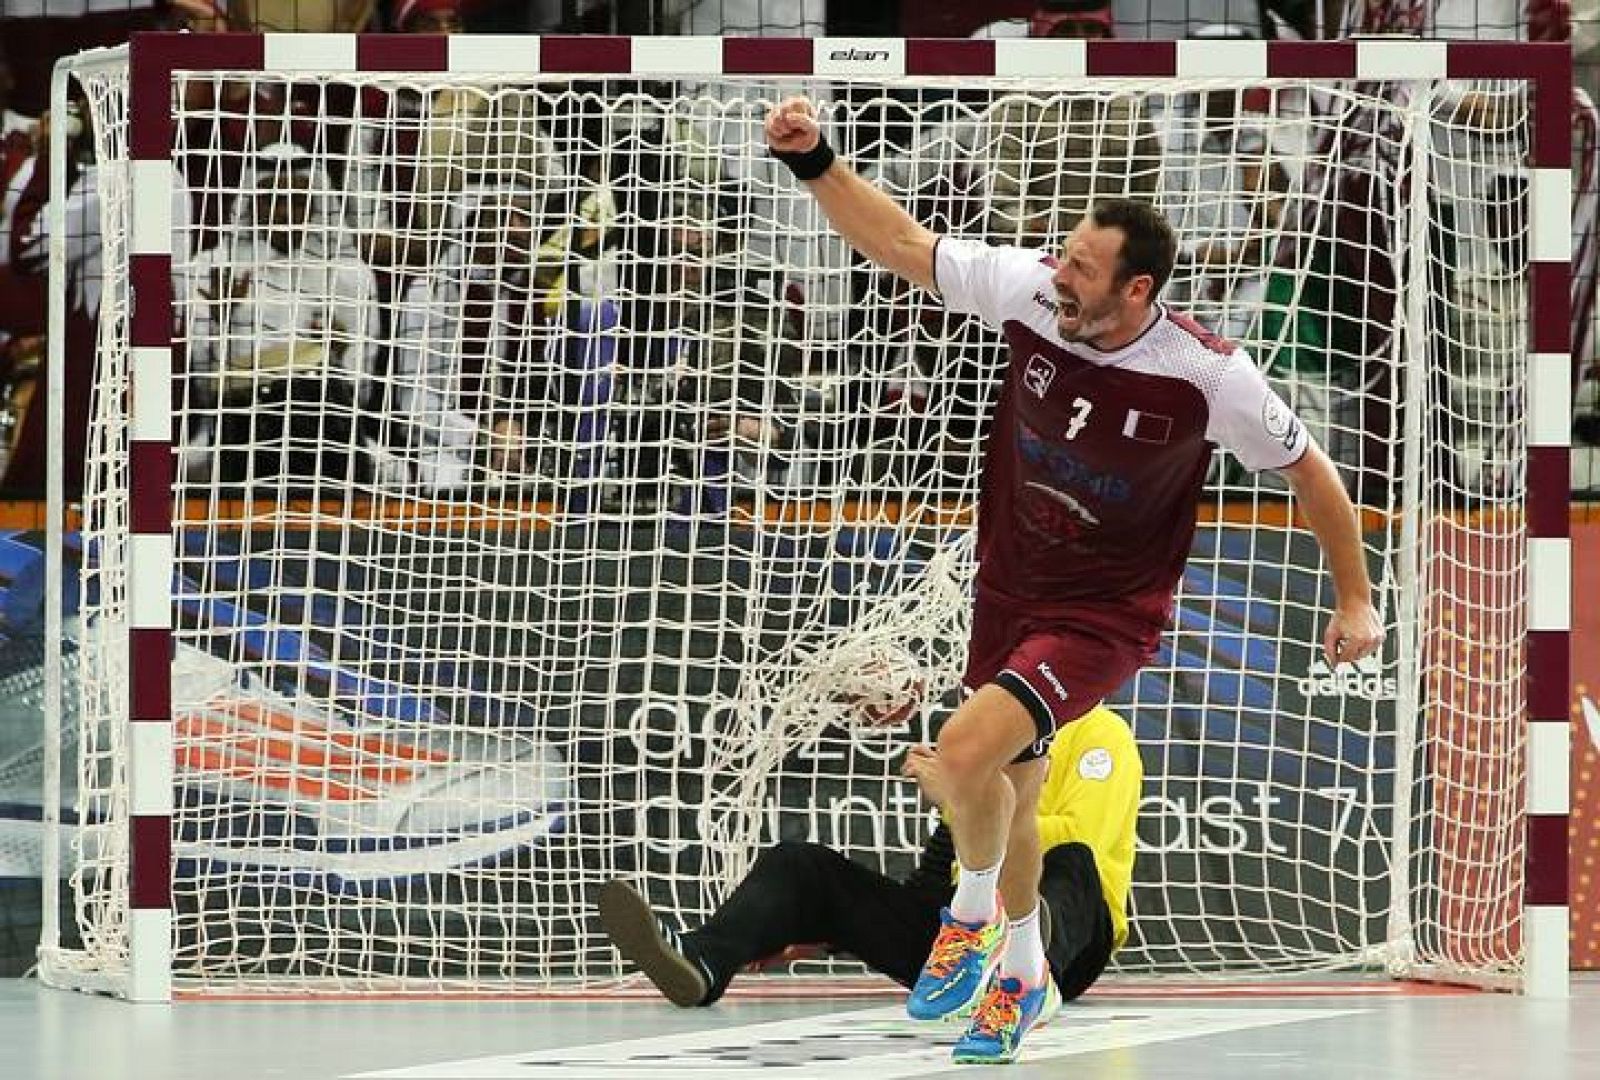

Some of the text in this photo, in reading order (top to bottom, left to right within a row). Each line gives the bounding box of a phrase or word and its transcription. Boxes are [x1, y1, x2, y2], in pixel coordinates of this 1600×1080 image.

[830, 48, 890, 61] elan
[1065, 397, 1092, 440] 7
[1297, 672, 1398, 698] adidas
[1319, 786, 1358, 854] 7
